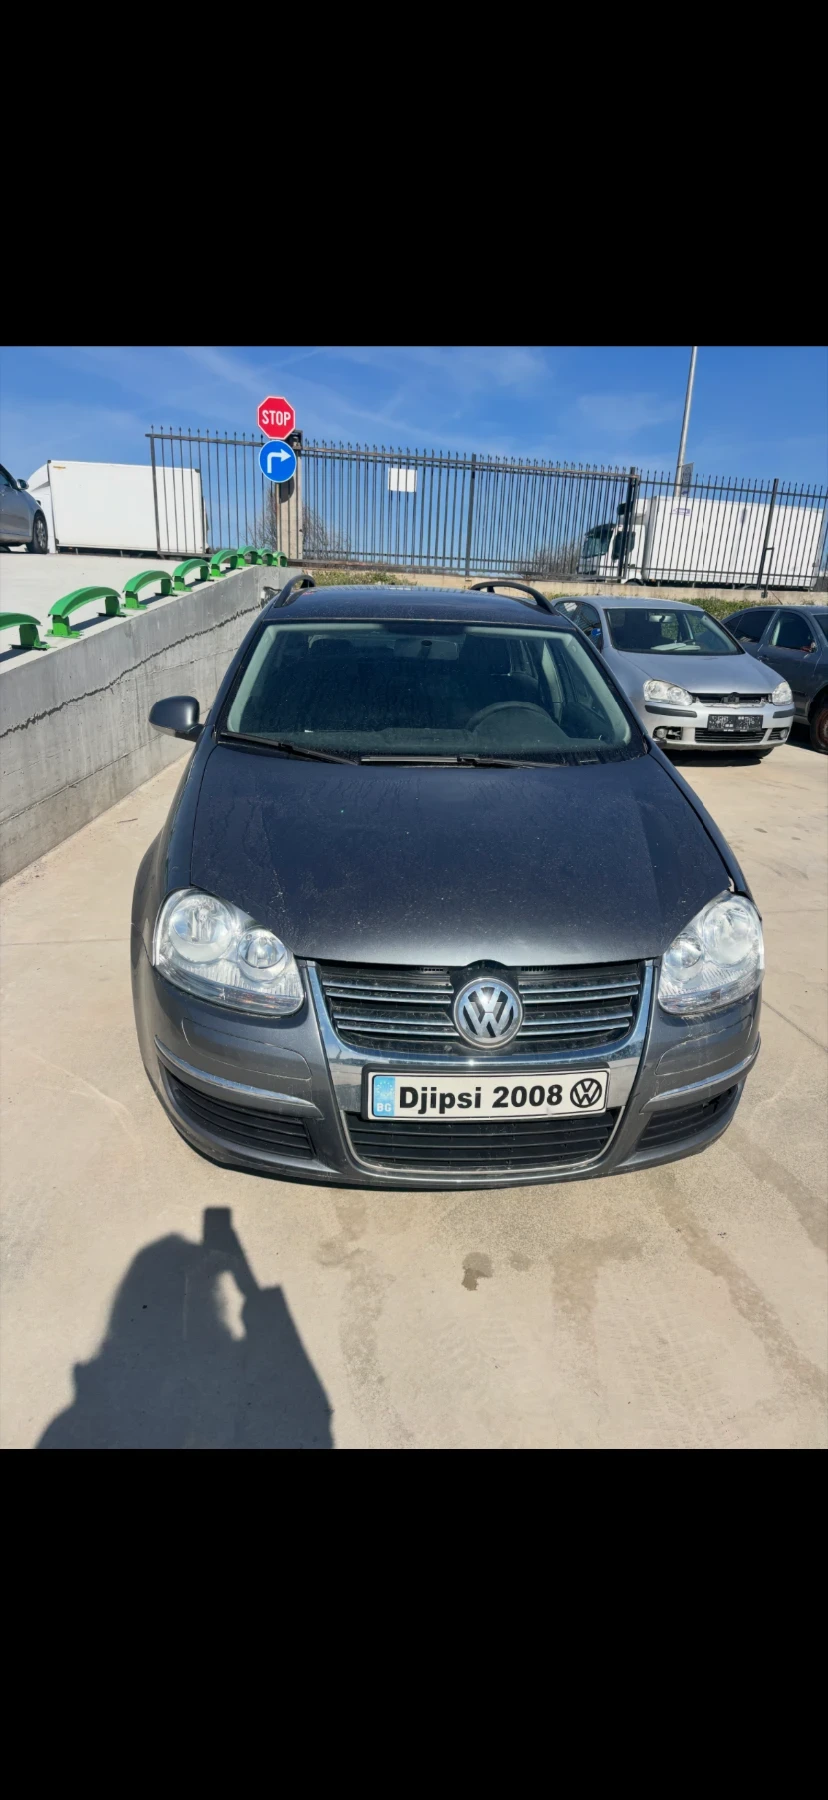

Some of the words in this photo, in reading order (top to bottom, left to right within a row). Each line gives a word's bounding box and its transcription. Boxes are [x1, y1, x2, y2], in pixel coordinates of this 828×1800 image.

[262, 409, 291, 426] STOP
[376, 1102, 392, 1113] BG
[399, 1086, 481, 1114] Djipsi
[492, 1084, 563, 1108] 2008
